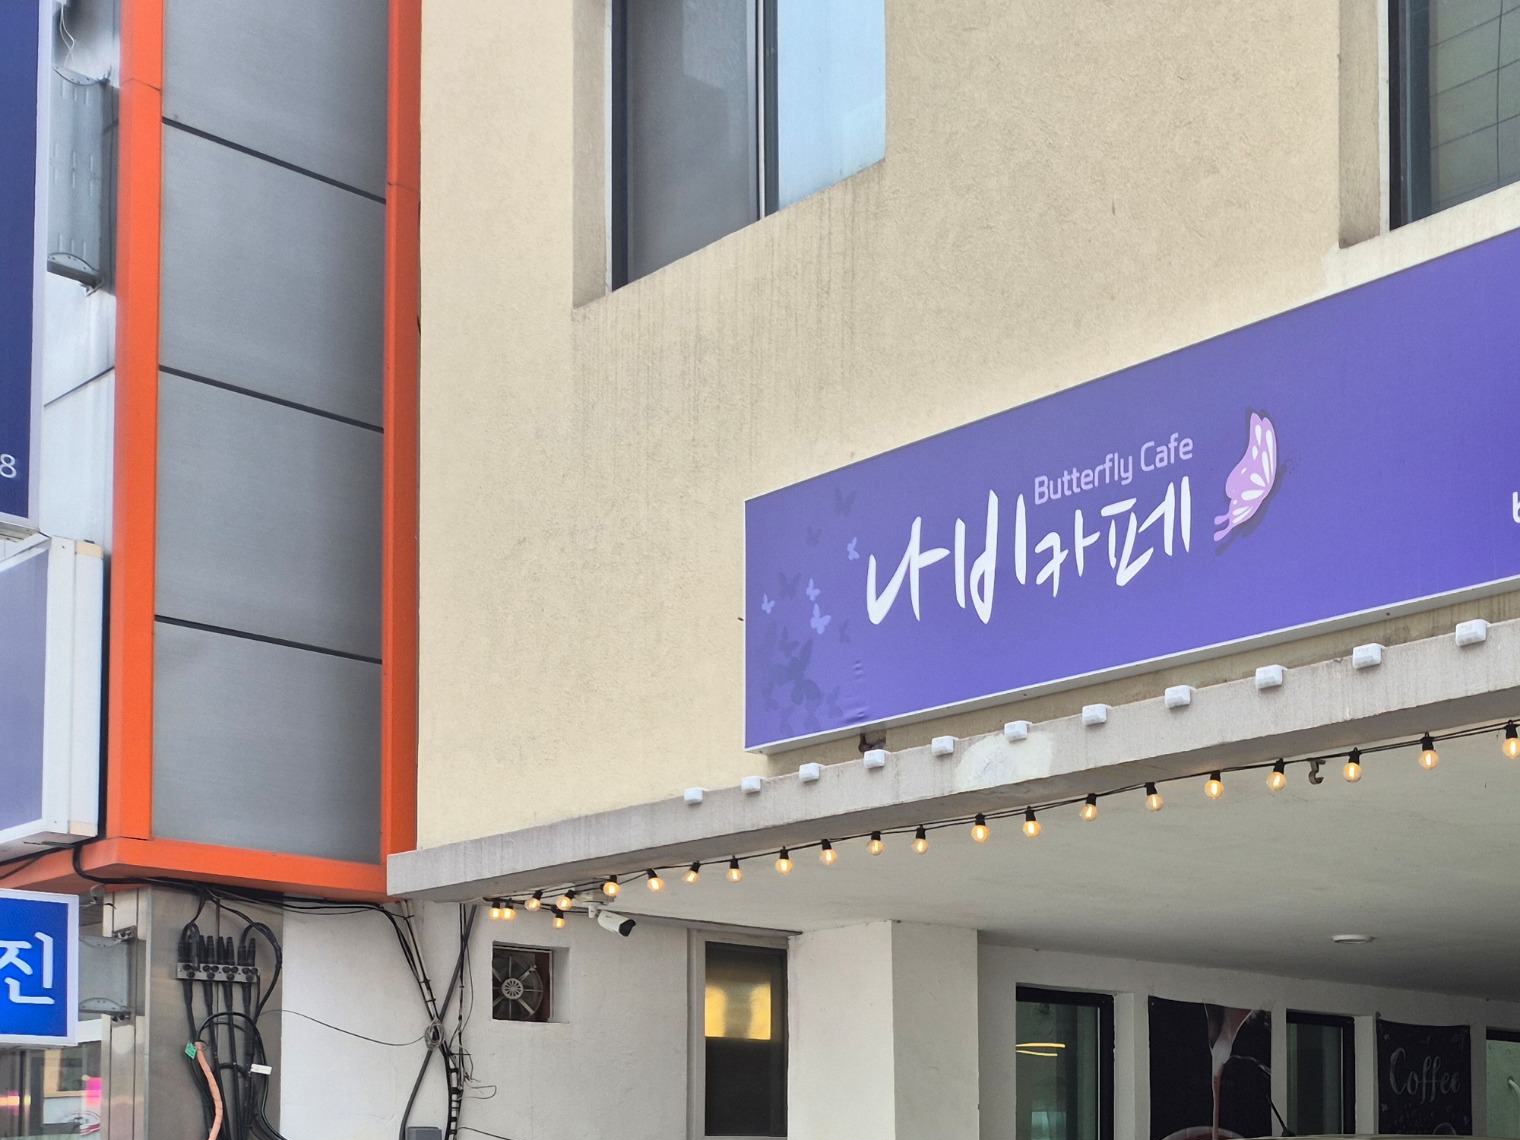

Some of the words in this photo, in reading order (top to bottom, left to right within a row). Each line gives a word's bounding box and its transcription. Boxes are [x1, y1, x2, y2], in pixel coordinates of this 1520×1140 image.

[1034, 451, 1133, 506] Butterfly
[1140, 433, 1193, 473] Cafe
[1389, 1047, 1461, 1104] Coffee
